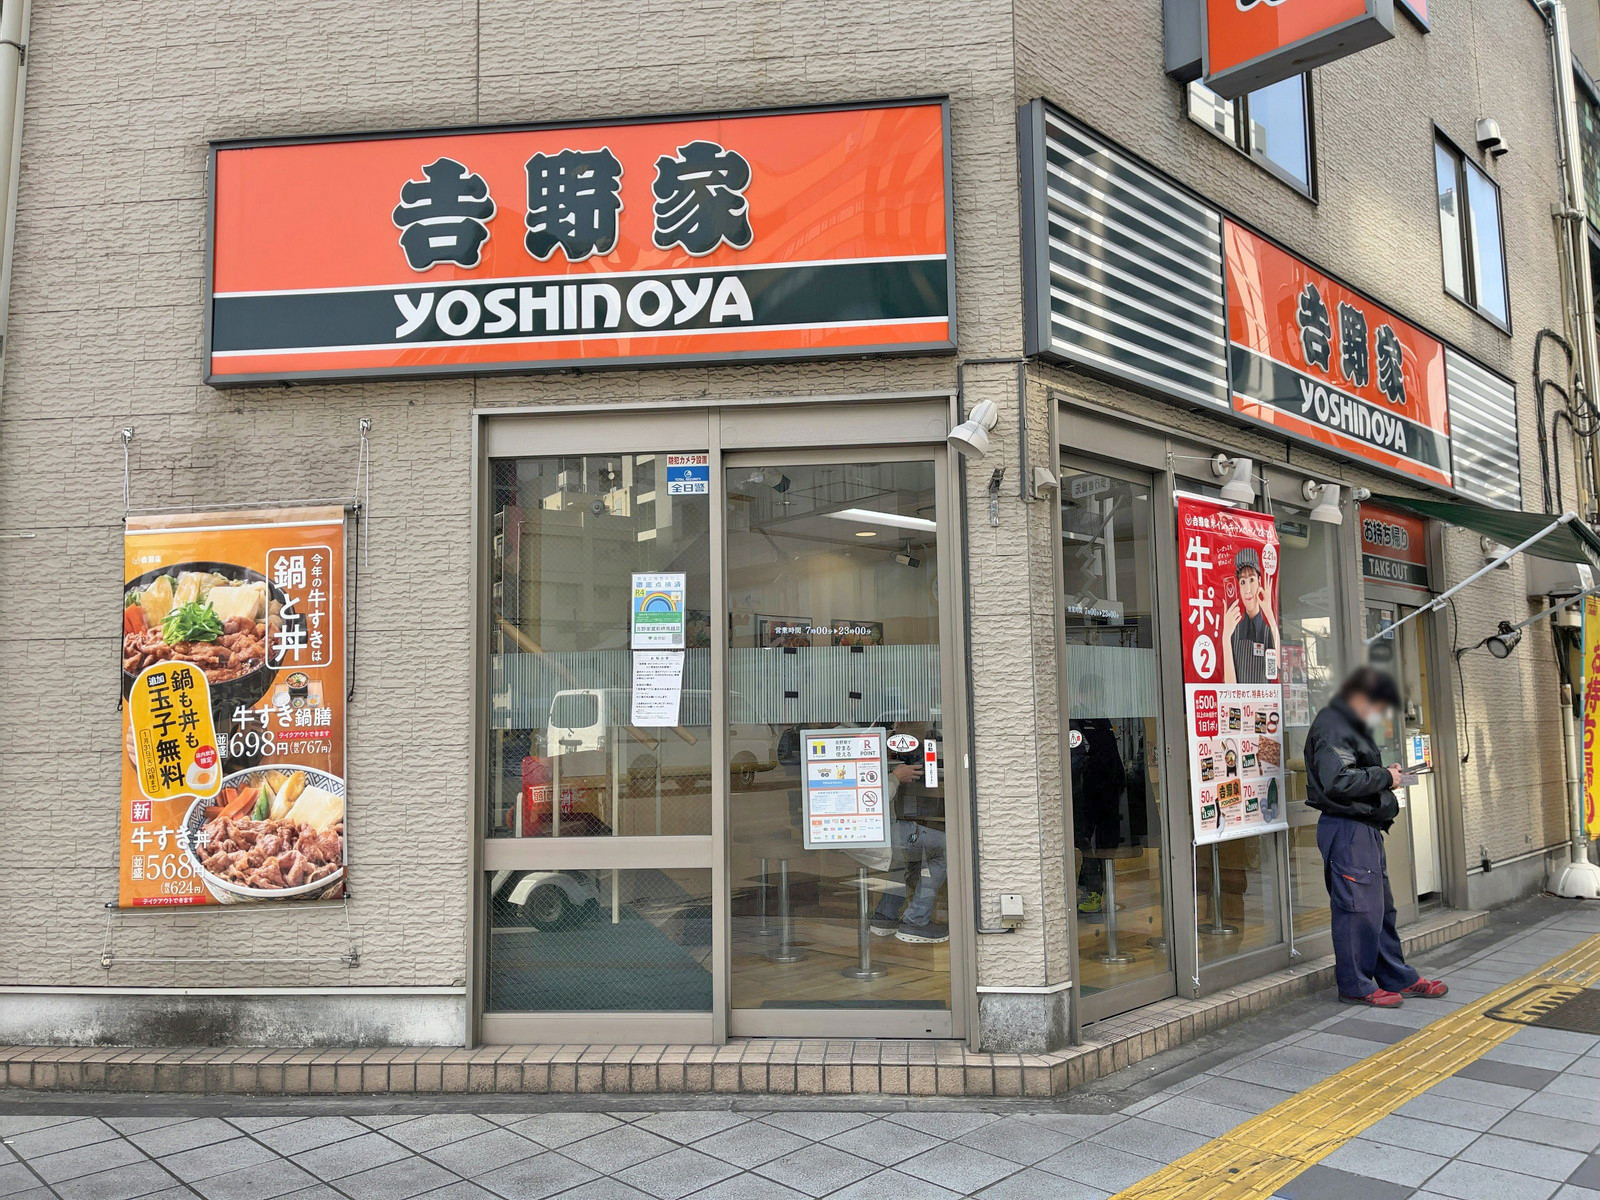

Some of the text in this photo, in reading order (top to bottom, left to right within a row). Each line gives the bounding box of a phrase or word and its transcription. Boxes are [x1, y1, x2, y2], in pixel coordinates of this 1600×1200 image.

[391, 139, 754, 273] 吉野家
[394, 276, 754, 339] YOSHINOYA
[1296, 282, 1407, 405] 吉野家
[1299, 377, 1408, 453] YOSHINOYA
[668, 455, 708, 465] 防犯カメラ設置
[671, 483, 705, 493] 全日警
[1363, 518, 1409, 550] お持ち帰り
[1368, 558, 1408, 580] TAKE OUT
[272, 555, 308, 662] 鍋と丼
[307, 553, 326, 661] 今年の牛すきは
[775, 626, 801, 634] 営業時間
[1200, 648, 1211, 673] 2
[148, 674, 165, 686] 追加
[171, 668, 199, 749] 鍋も丼も
[232, 704, 332, 730] 牛すき鍋膳
[149, 687, 185, 789] 玉子無料
[217, 733, 228, 757] 並盛
[229, 731, 288, 758] 698円
[278, 730, 330, 739] テイクアウトできます
[200, 757, 213, 765] 限定
[133, 802, 150, 821] 新
[130, 825, 211, 852] 牛すき丼
[132, 856, 143, 880] 並盛
[146, 854, 205, 881] 568円
[142, 897, 194, 905] テイクアウトできます
